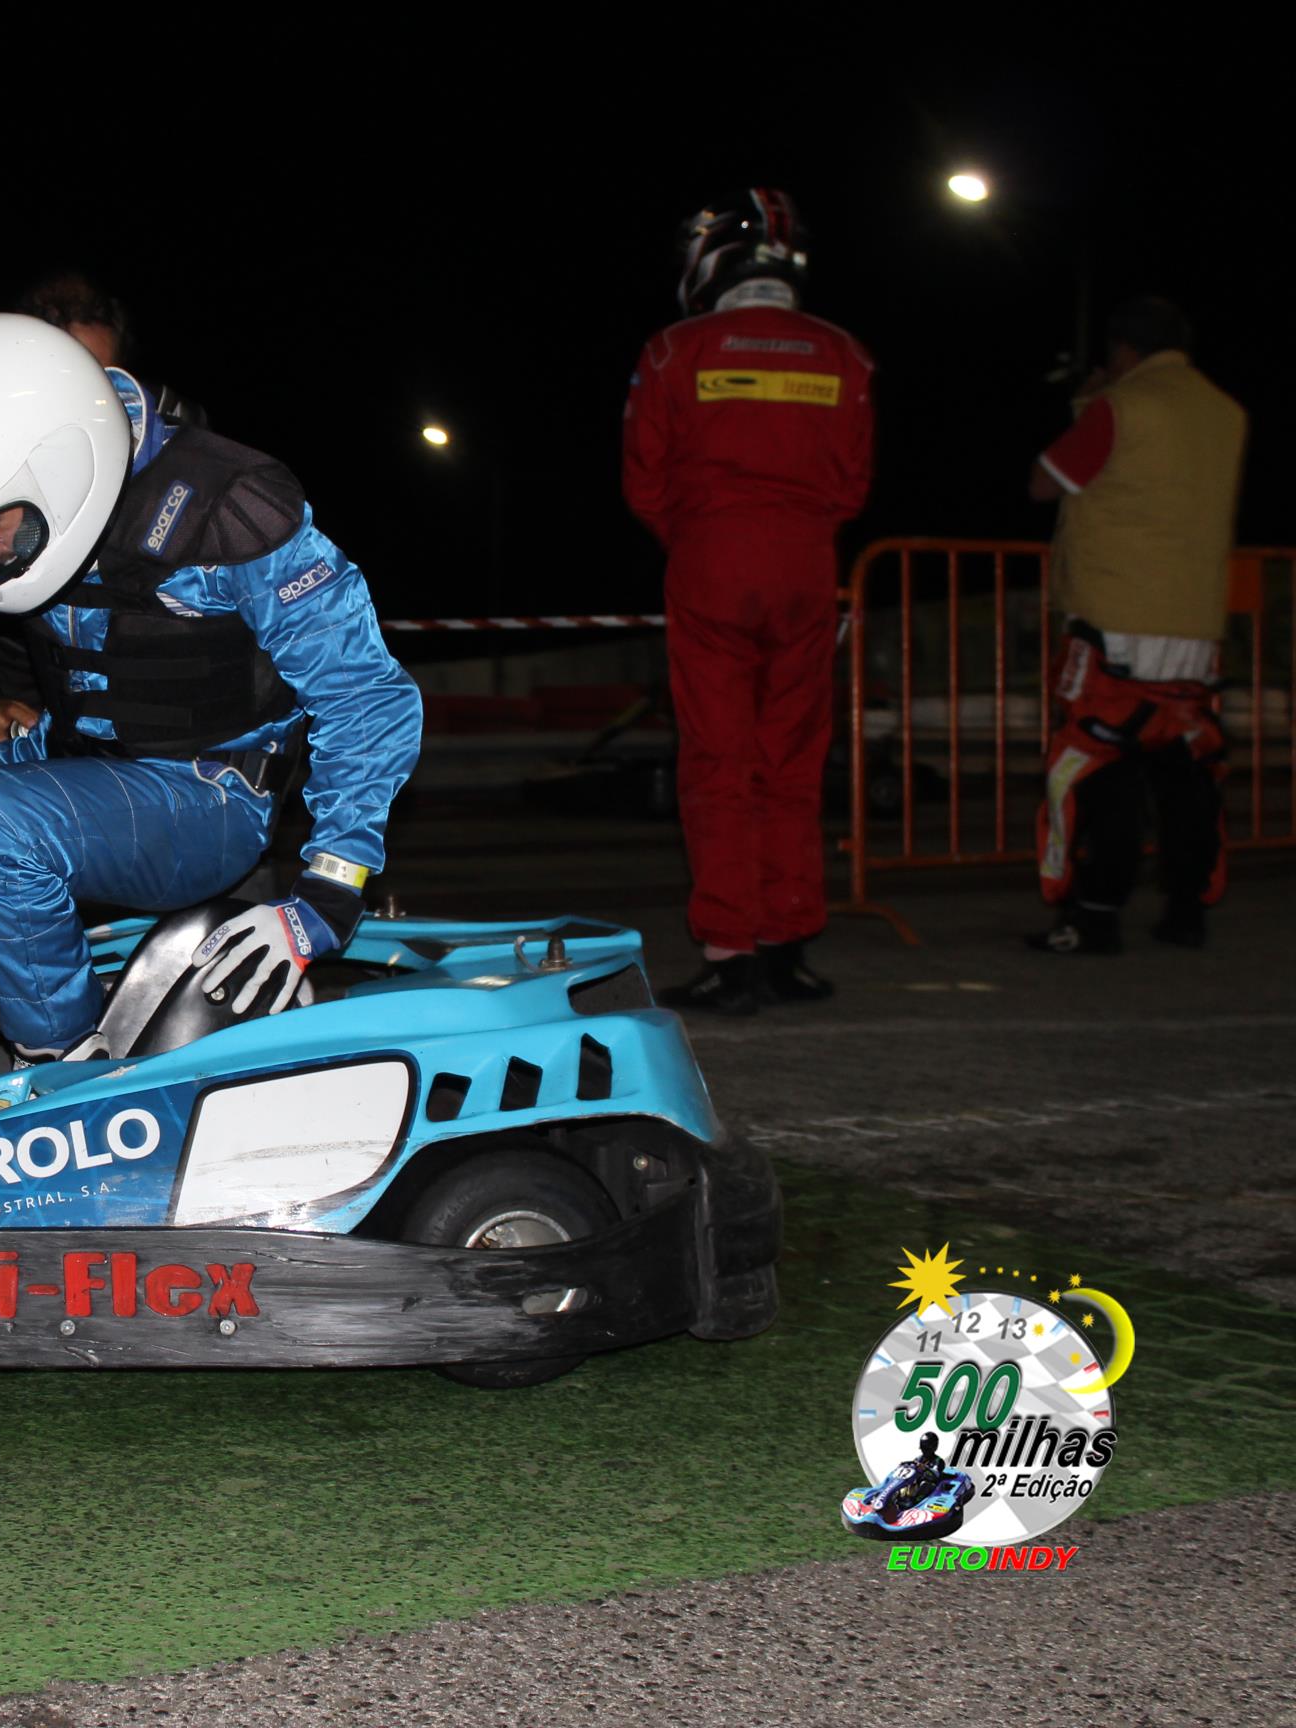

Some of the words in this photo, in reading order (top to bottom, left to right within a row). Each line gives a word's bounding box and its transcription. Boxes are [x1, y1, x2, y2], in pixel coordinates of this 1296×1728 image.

[147, 485, 188, 552] sparco
[202, 925, 231, 957] sparco
[284, 906, 311, 956] sparco
[80, 1182, 118, 1199] S.A.
